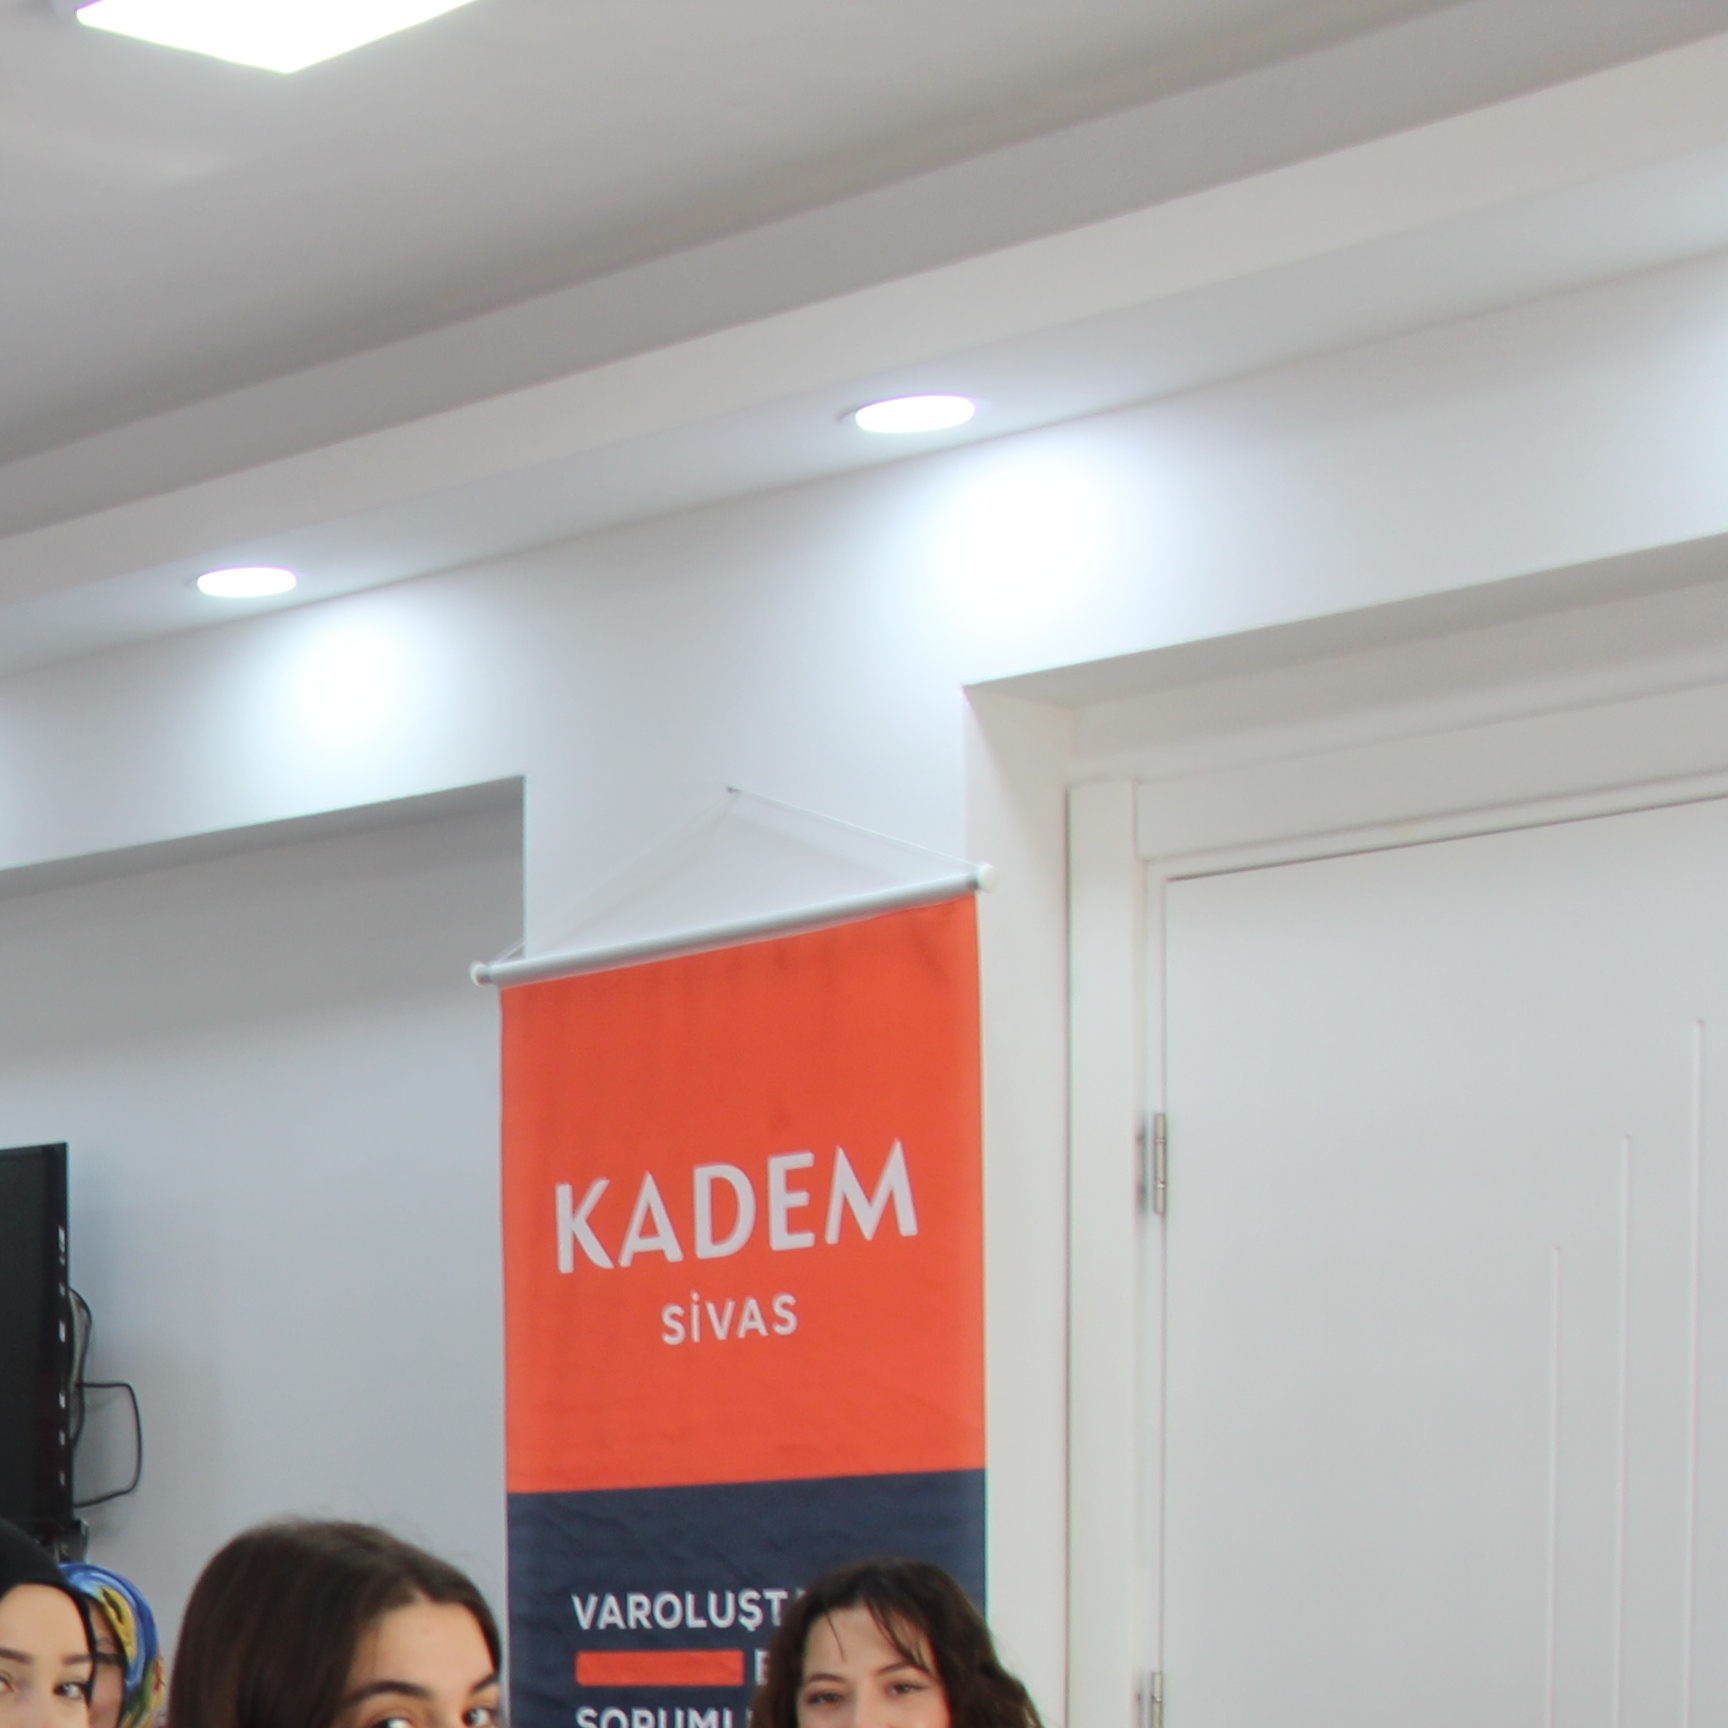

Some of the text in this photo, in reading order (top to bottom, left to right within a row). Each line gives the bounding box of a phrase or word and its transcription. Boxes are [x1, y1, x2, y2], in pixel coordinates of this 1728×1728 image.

[554, 1137, 919, 1275] KADEM
[660, 1290, 799, 1346] SİVAS
[571, 1587, 806, 1632] VAROLUŞT
